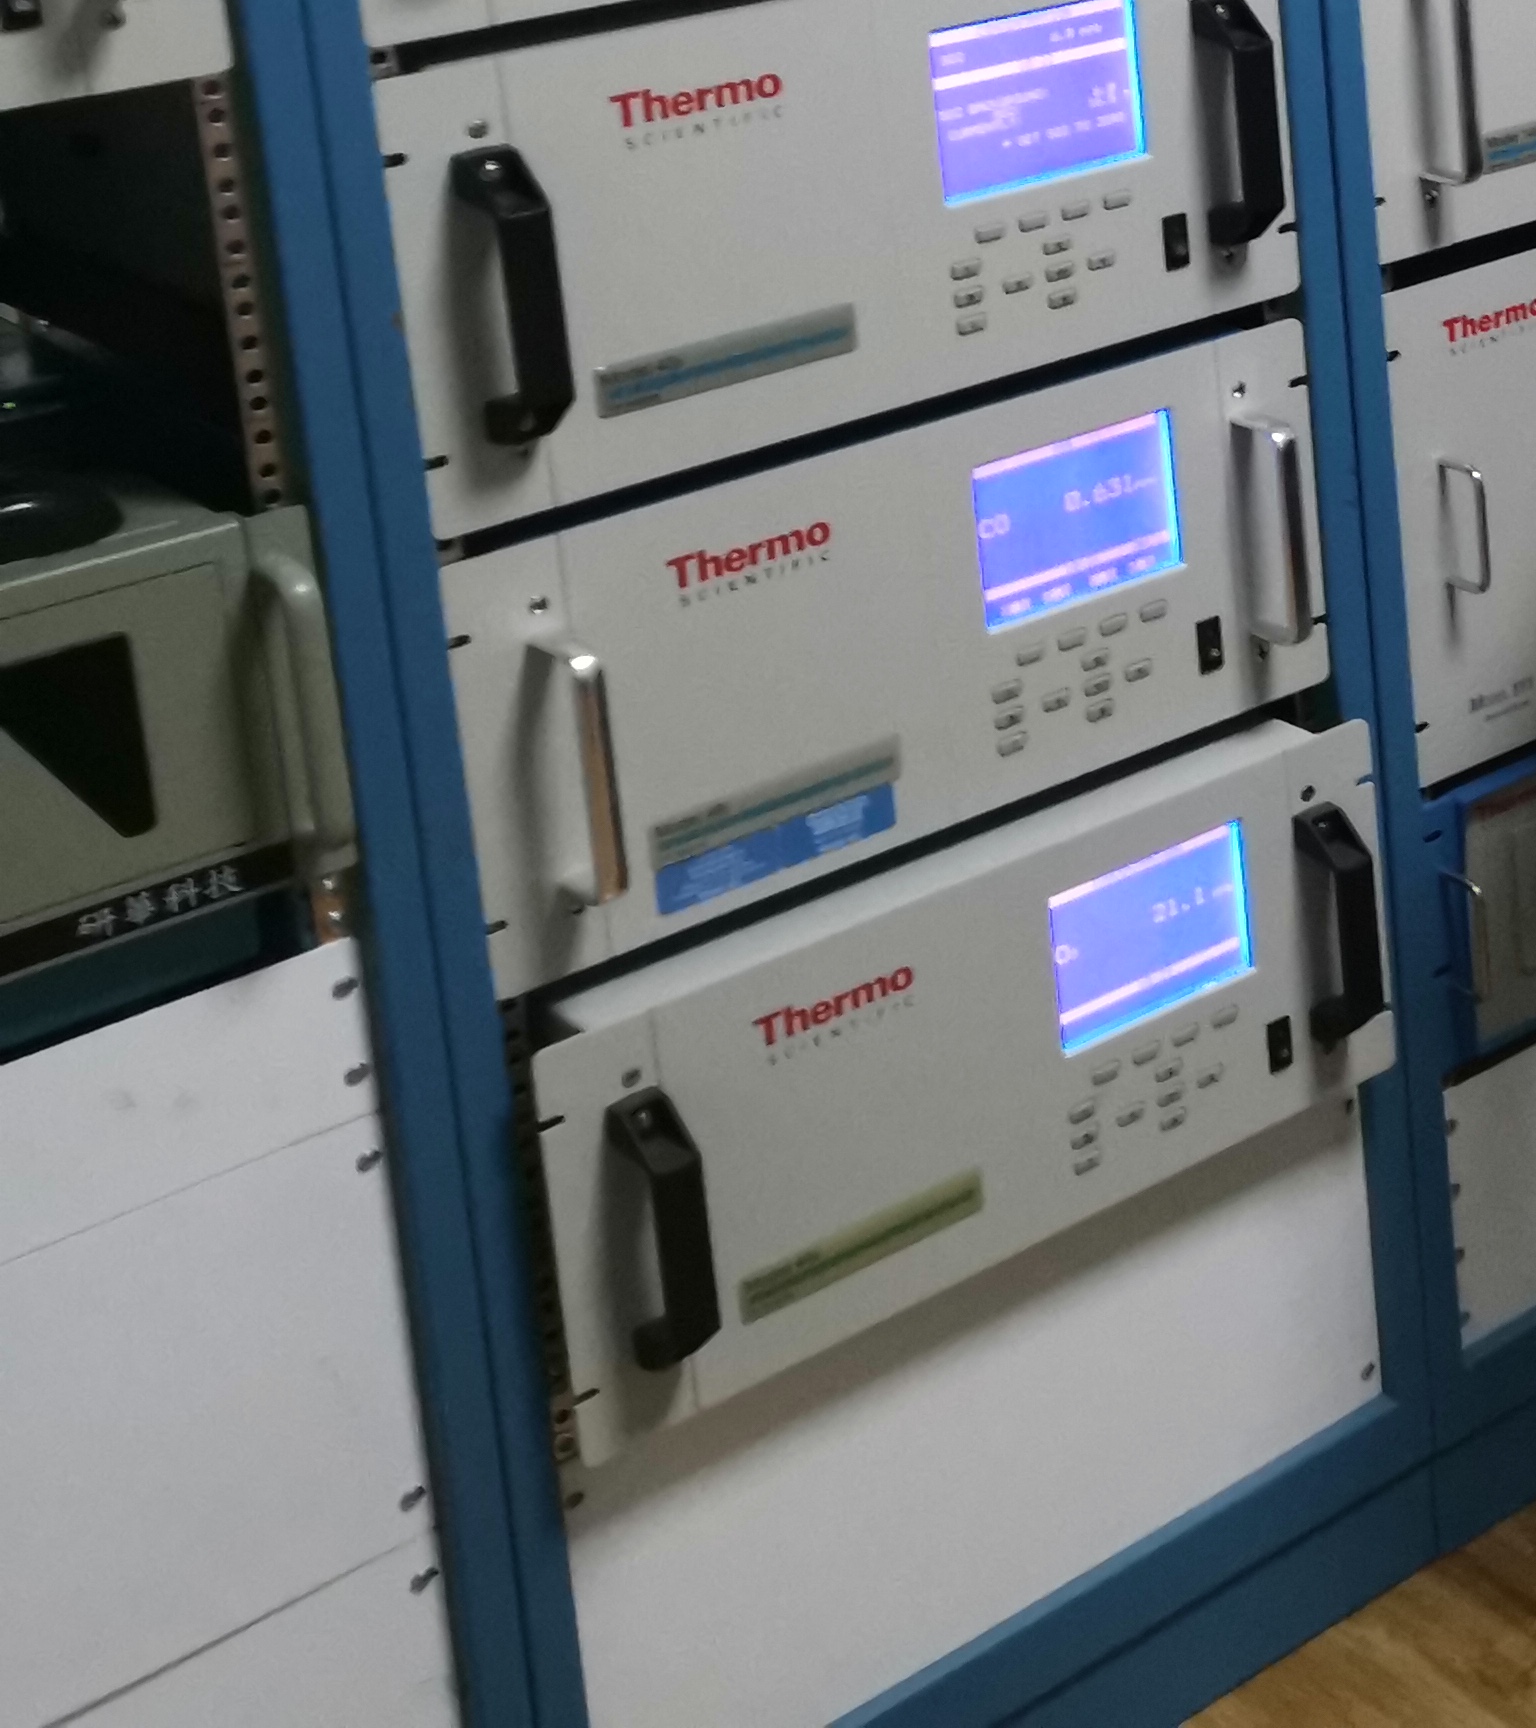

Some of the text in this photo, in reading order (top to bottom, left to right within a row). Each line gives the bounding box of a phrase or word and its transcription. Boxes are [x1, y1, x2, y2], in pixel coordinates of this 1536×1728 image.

[609, 71, 784, 130] Thermo
[666, 519, 833, 591] Thermo
[752, 964, 914, 1048] Thermo
